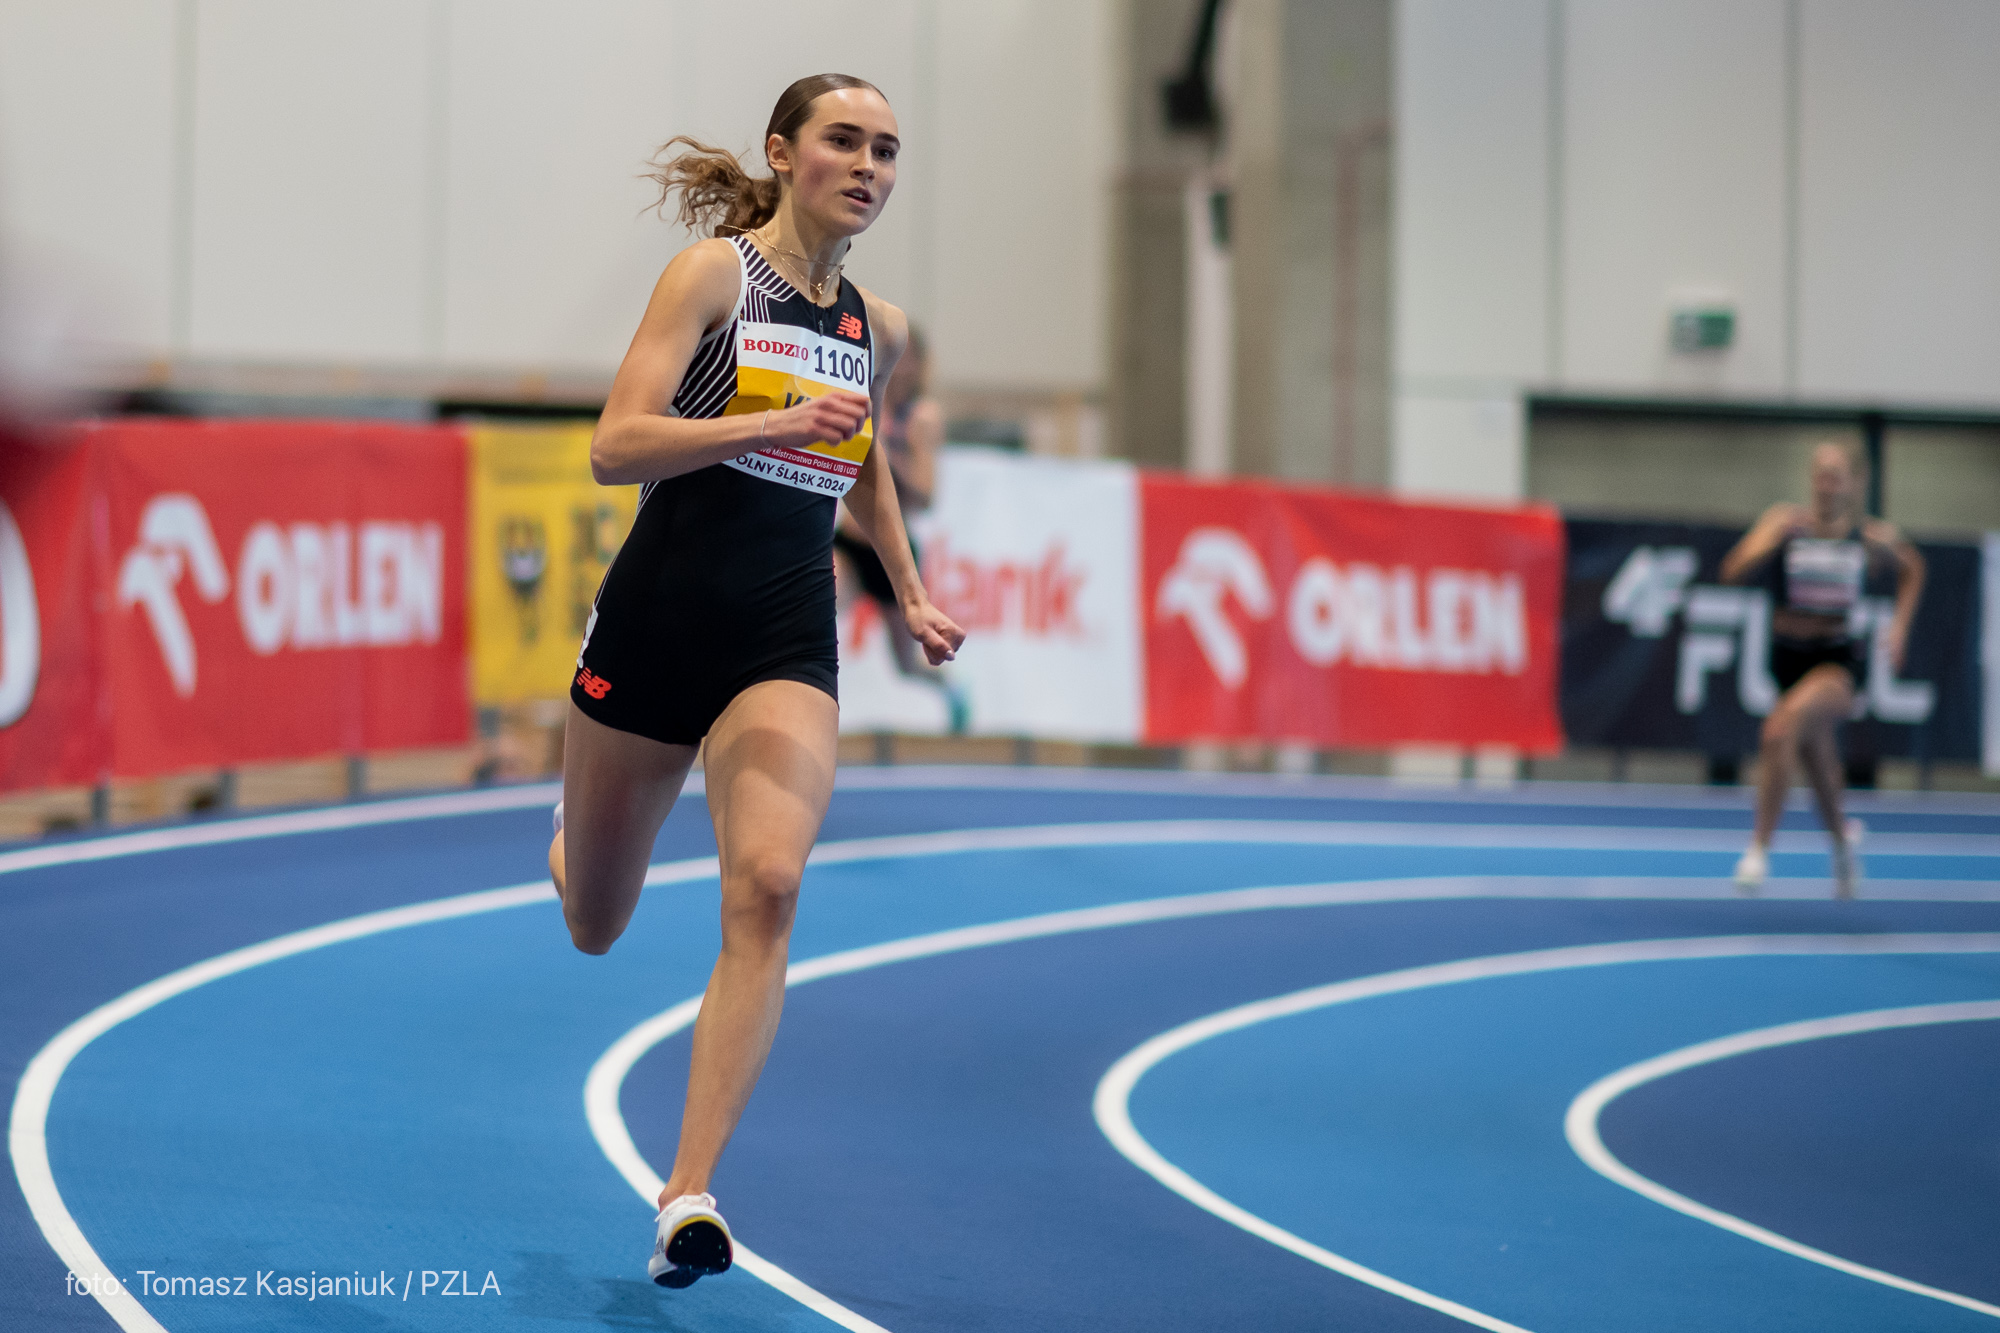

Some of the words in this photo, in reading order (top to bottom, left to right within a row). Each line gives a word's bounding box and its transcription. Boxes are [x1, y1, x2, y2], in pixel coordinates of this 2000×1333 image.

[743, 338, 809, 361] BODZIO
[814, 345, 866, 386] 1100
[736, 455, 775, 475] OLNY
[775, 463, 815, 486] ŚLĄSK
[816, 476, 845, 493] 2024
[772, 448, 812, 465] Mistrzostwa
[812, 458, 833, 470] Polski
[240, 520, 444, 655] ORLEN
[1290, 557, 1527, 675] ORLEN
[1675, 583, 1937, 725] FUL
